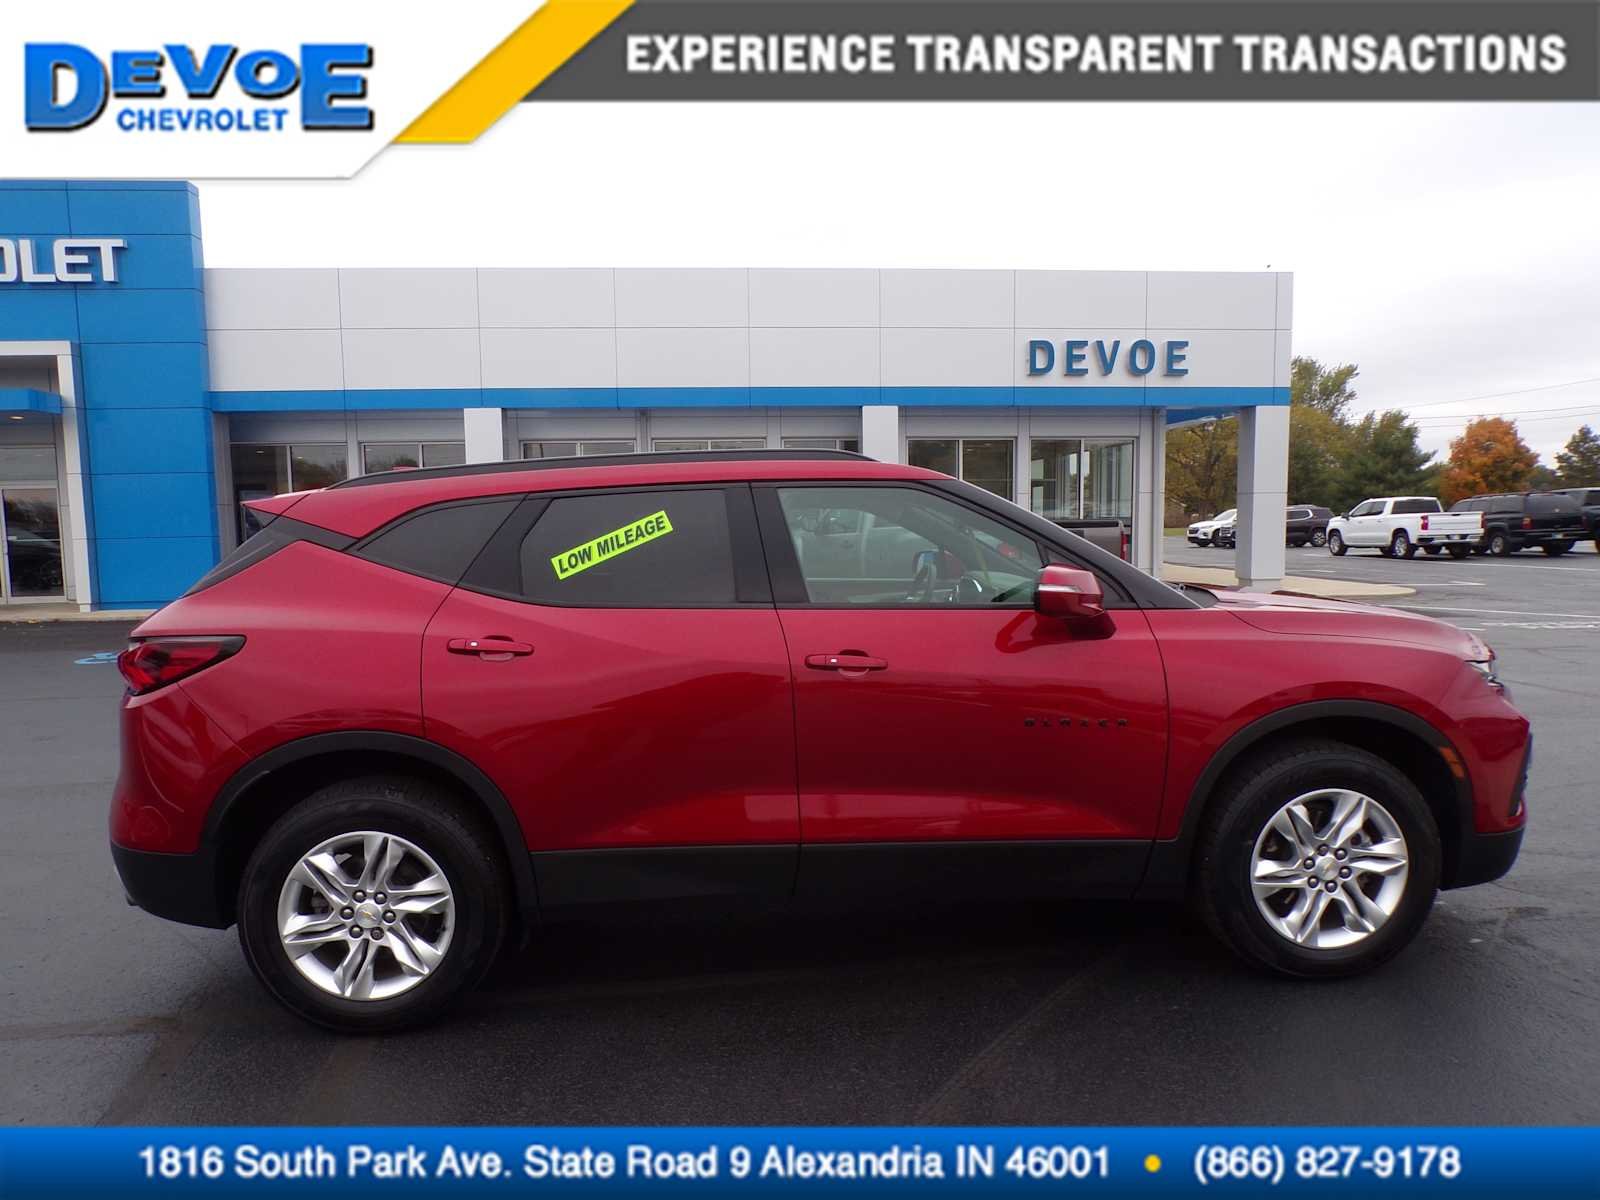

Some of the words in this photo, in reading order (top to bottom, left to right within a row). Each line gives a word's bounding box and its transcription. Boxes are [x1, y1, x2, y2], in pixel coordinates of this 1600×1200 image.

[1027, 339, 1189, 376] DEVOE
[557, 545, 593, 574] LOW
[596, 515, 666, 557] MILEAGE
